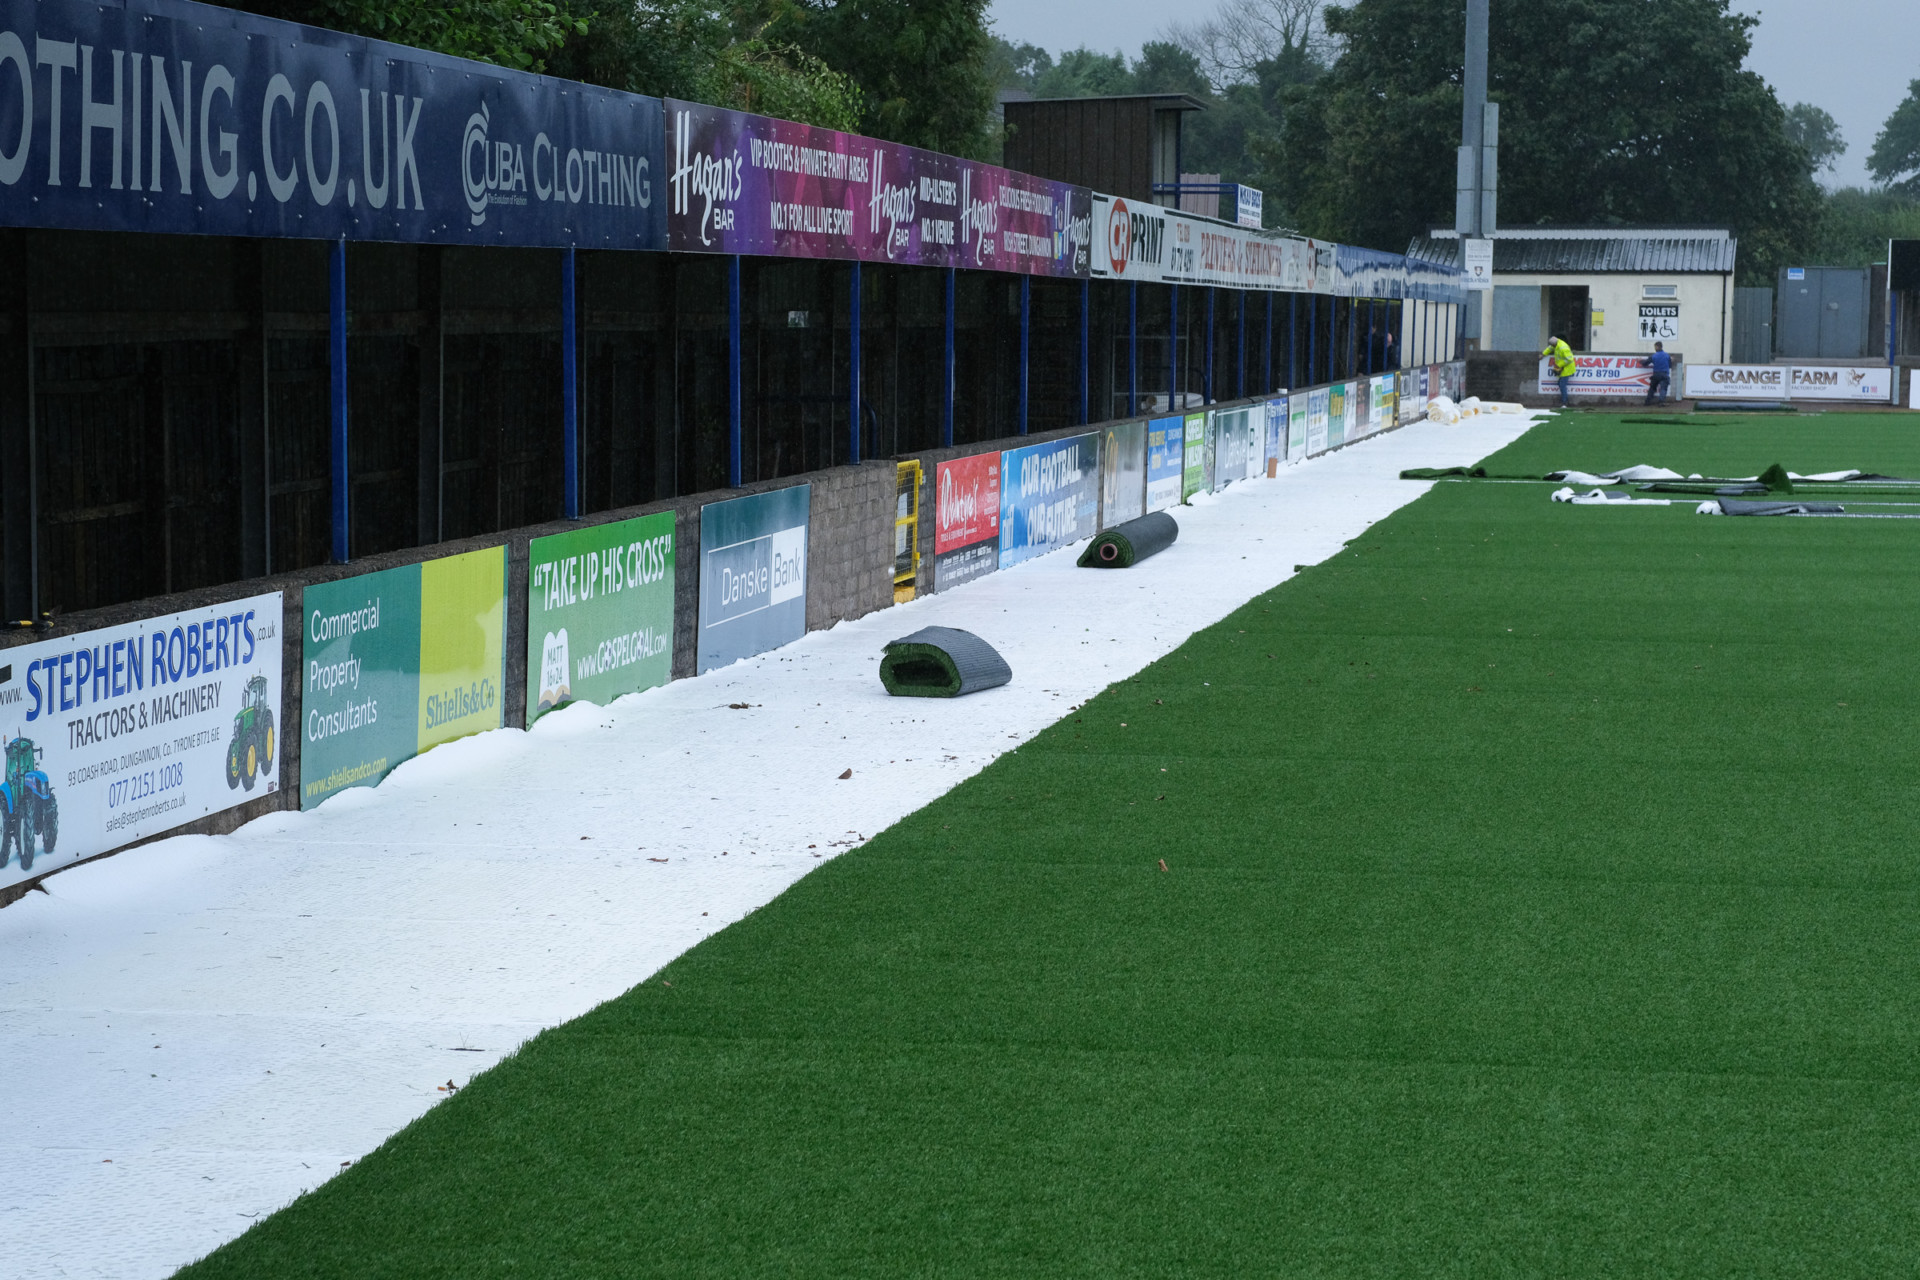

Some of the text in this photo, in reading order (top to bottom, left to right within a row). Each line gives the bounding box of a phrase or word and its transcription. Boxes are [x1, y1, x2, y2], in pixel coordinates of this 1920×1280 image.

[462, 112, 651, 214] CUBA CLOTHING
[670, 110, 742, 247] Hagan's
[750, 138, 869, 183] VIP BOOTHS & PRIVATE PARTY AREAS
[714, 208, 735, 231] BAR
[770, 201, 854, 236] NO.1 FOR ALL LIVE SPORT
[869, 149, 916, 259] Hagan's
[960, 168, 998, 267] Hagan's
[895, 228, 910, 247] BAR
[935, 219, 955, 246] VENUE
[983, 239, 995, 256] BAR
[1062, 190, 1090, 274] Hagan's
[1110, 210, 1165, 264] CR PRINT
[1201, 232, 1236, 273] PRINTERS
[1078, 250, 1087, 266] BAR
[1641, 307, 1677, 317] TOILETS
[1548, 357, 1613, 368] RMSAY
[1596, 369, 1620, 378] 8790
[1710, 368, 1838, 385] GRANGE FARM
[1021, 444, 1081, 498] OUR FOOTBALL
[1027, 494, 1077, 547] OUR FUTURE
[580, 552, 599, 601] UP
[602, 545, 624, 596] HIS
[722, 547, 801, 606] Danske Bank
[311, 597, 380, 643] Commercial
[26, 634, 144, 722] STEPHEN
[151, 609, 256, 688] ROBERTS
[310, 653, 361, 697] Property
[547, 643, 564, 668] MATT
[68, 681, 222, 750] TRACTORS & MACHINERY
[308, 696, 378, 742] Consultants
[426, 677, 495, 730] Shiells&Co
[68, 727, 220, 787] 93 COASH ROAD, DUNGANNON, Co. TYRONE BT71 6JE
[305, 756, 387, 798] www.shiellsandco.com
[109, 761, 183, 809] 077 2151 1008
[106, 791, 186, 833] sales@stephenroberts.co.uk
